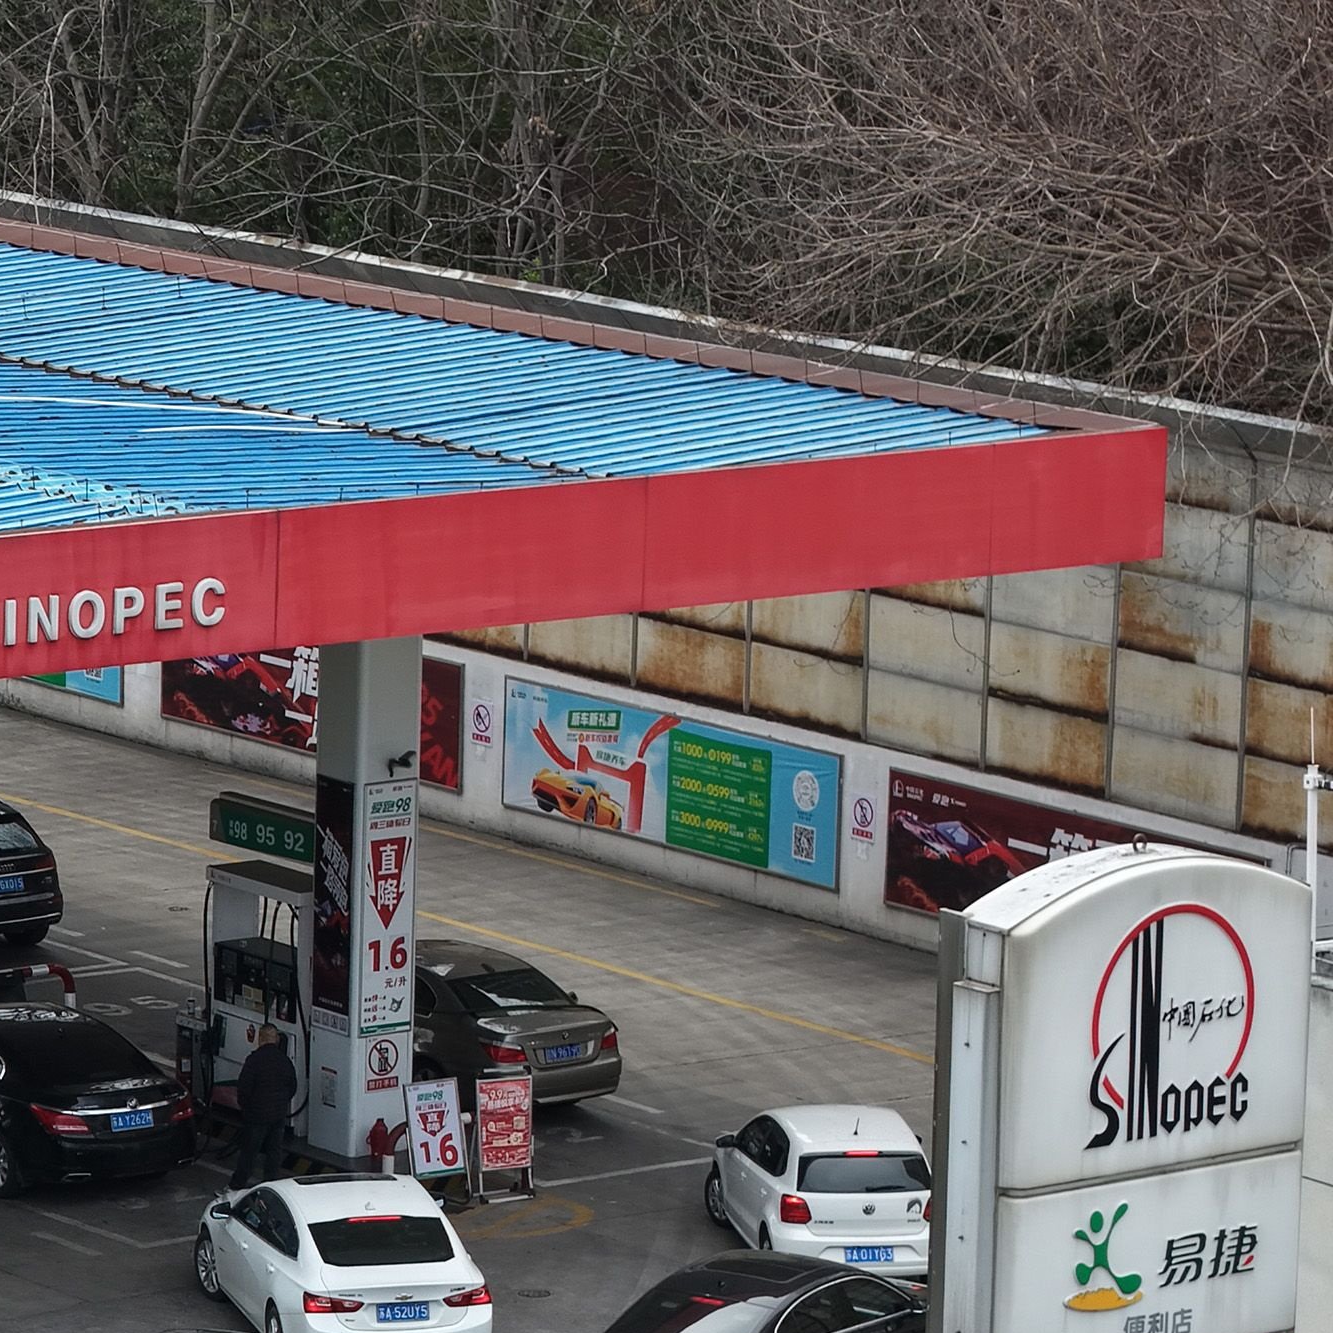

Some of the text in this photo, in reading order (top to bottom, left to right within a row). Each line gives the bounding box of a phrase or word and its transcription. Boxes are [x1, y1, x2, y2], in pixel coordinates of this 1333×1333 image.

[234, 820, 248, 841] 98
[255, 823, 276, 846] 95
[284, 830, 305, 853] 92
[377, 843, 399, 913] 直降
[368, 936, 408, 973] 1.6
[384, 976, 407, 989] 元/升
[1085, 917, 1249, 1150] SINOPEC
[420, 1132, 459, 1168] 1.6
[1158, 1224, 1259, 1288] 易捷
